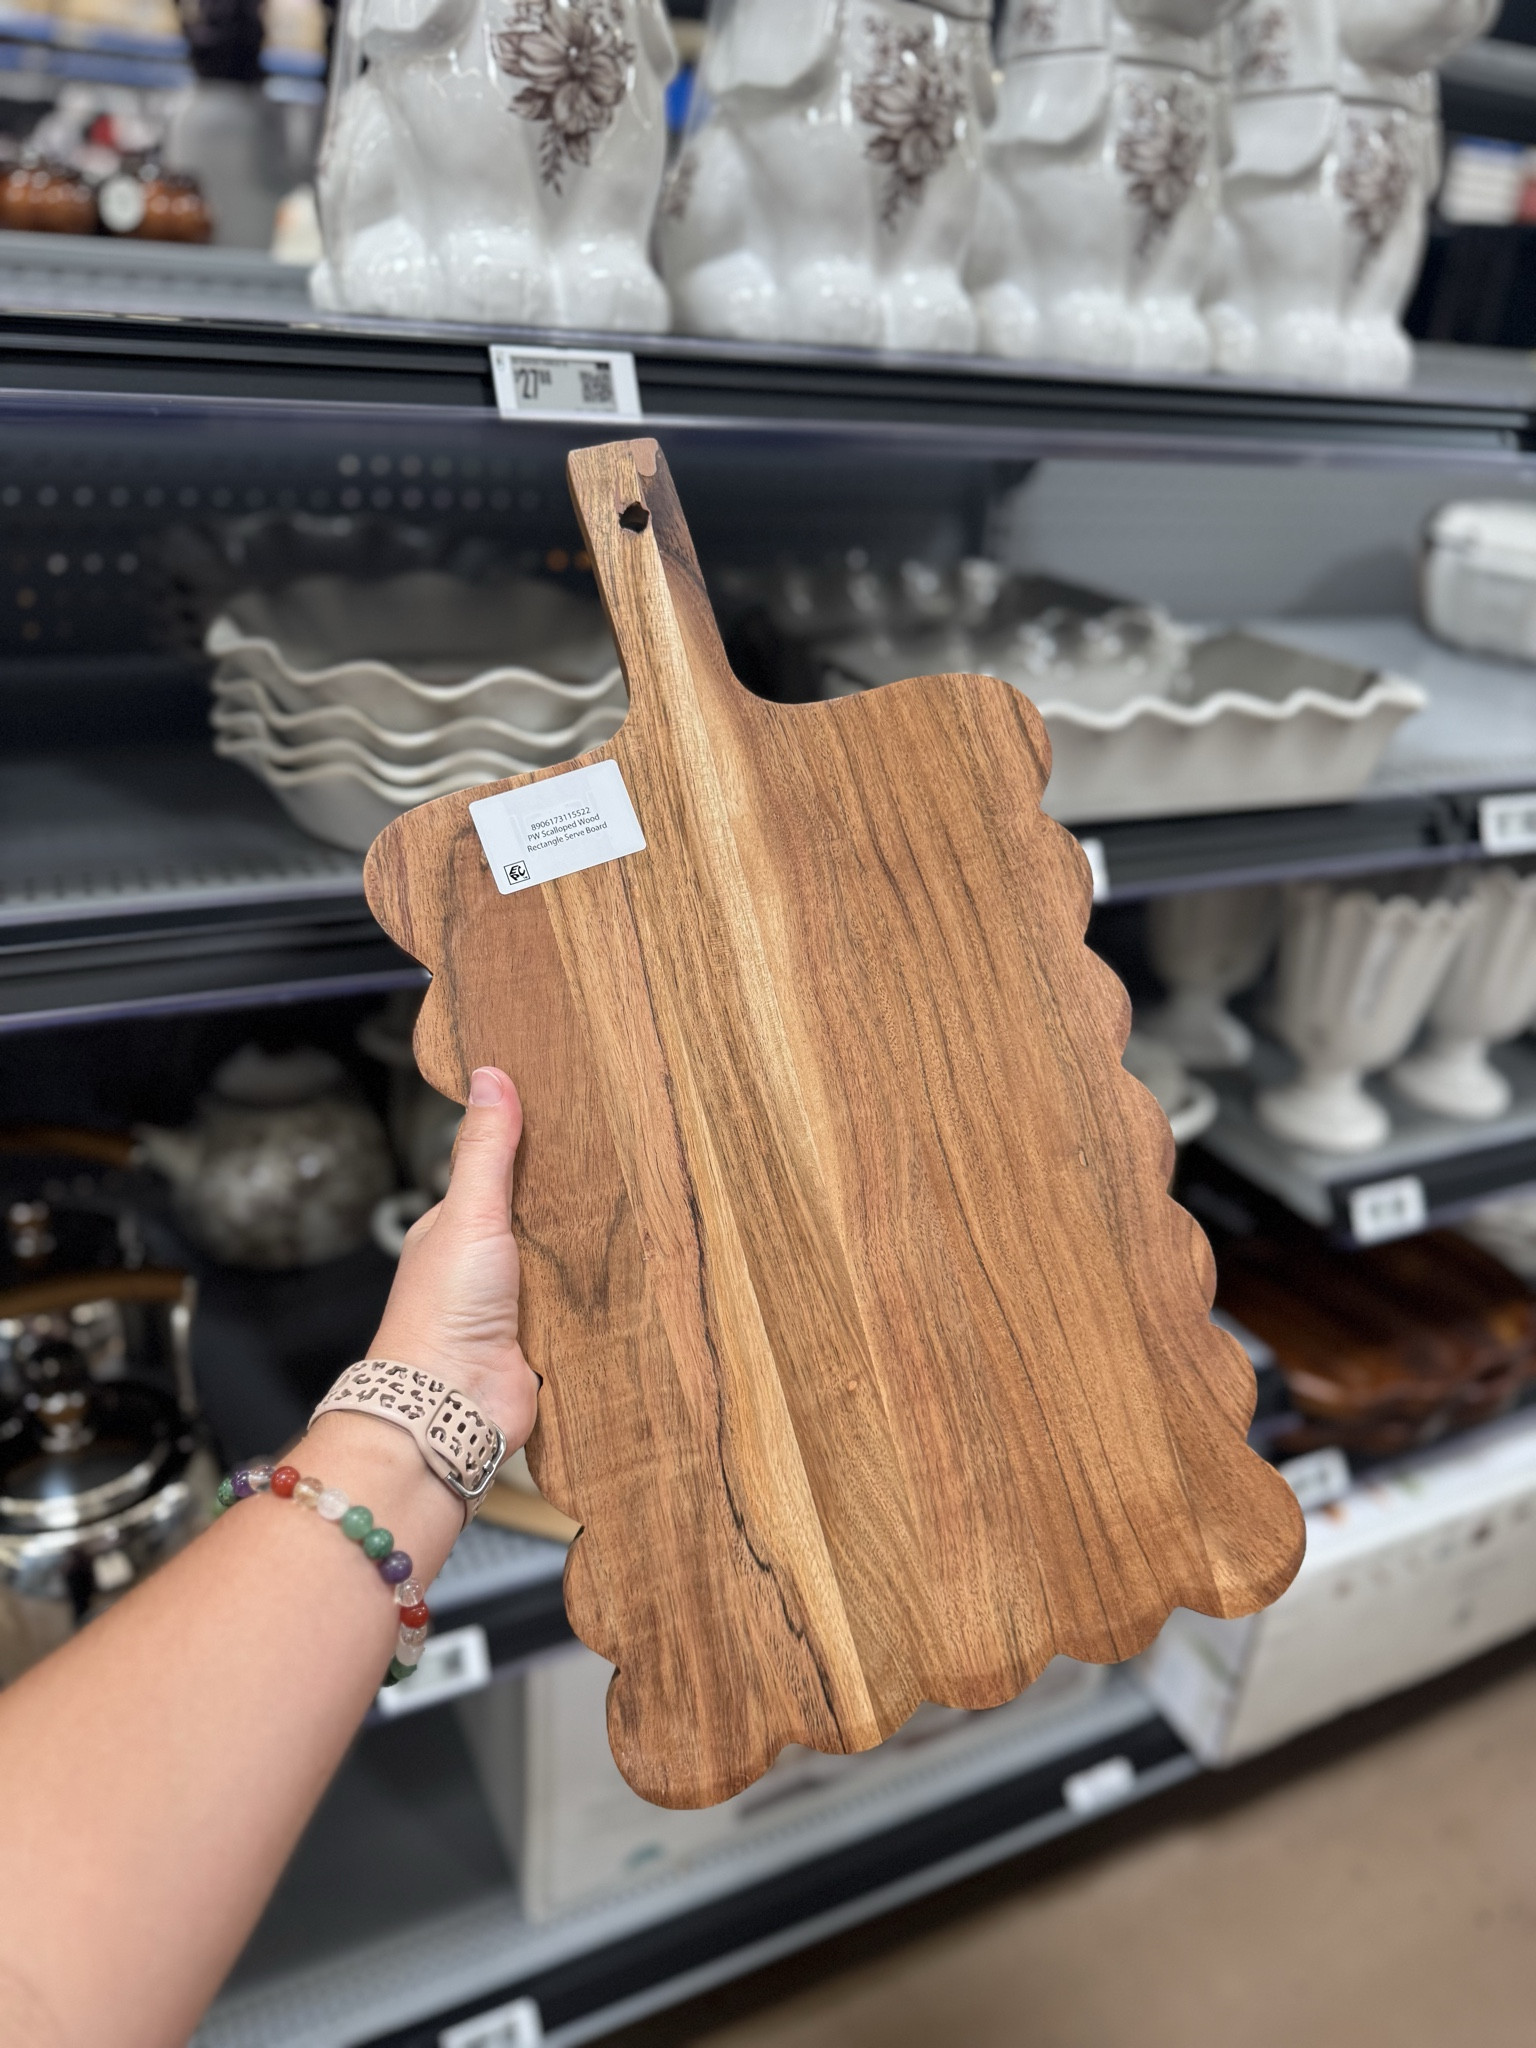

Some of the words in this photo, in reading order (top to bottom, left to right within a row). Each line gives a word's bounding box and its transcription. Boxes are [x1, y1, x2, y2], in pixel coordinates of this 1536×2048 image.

[527, 832, 540, 842] PW
[542, 821, 578, 839] Scalloped
[577, 814, 600, 826] Wood
[531, 807, 591, 831] 8906173115522
[527, 836, 564, 852] Rectangle
[564, 829, 585, 841] Serve
[586, 821, 608, 834] Board
